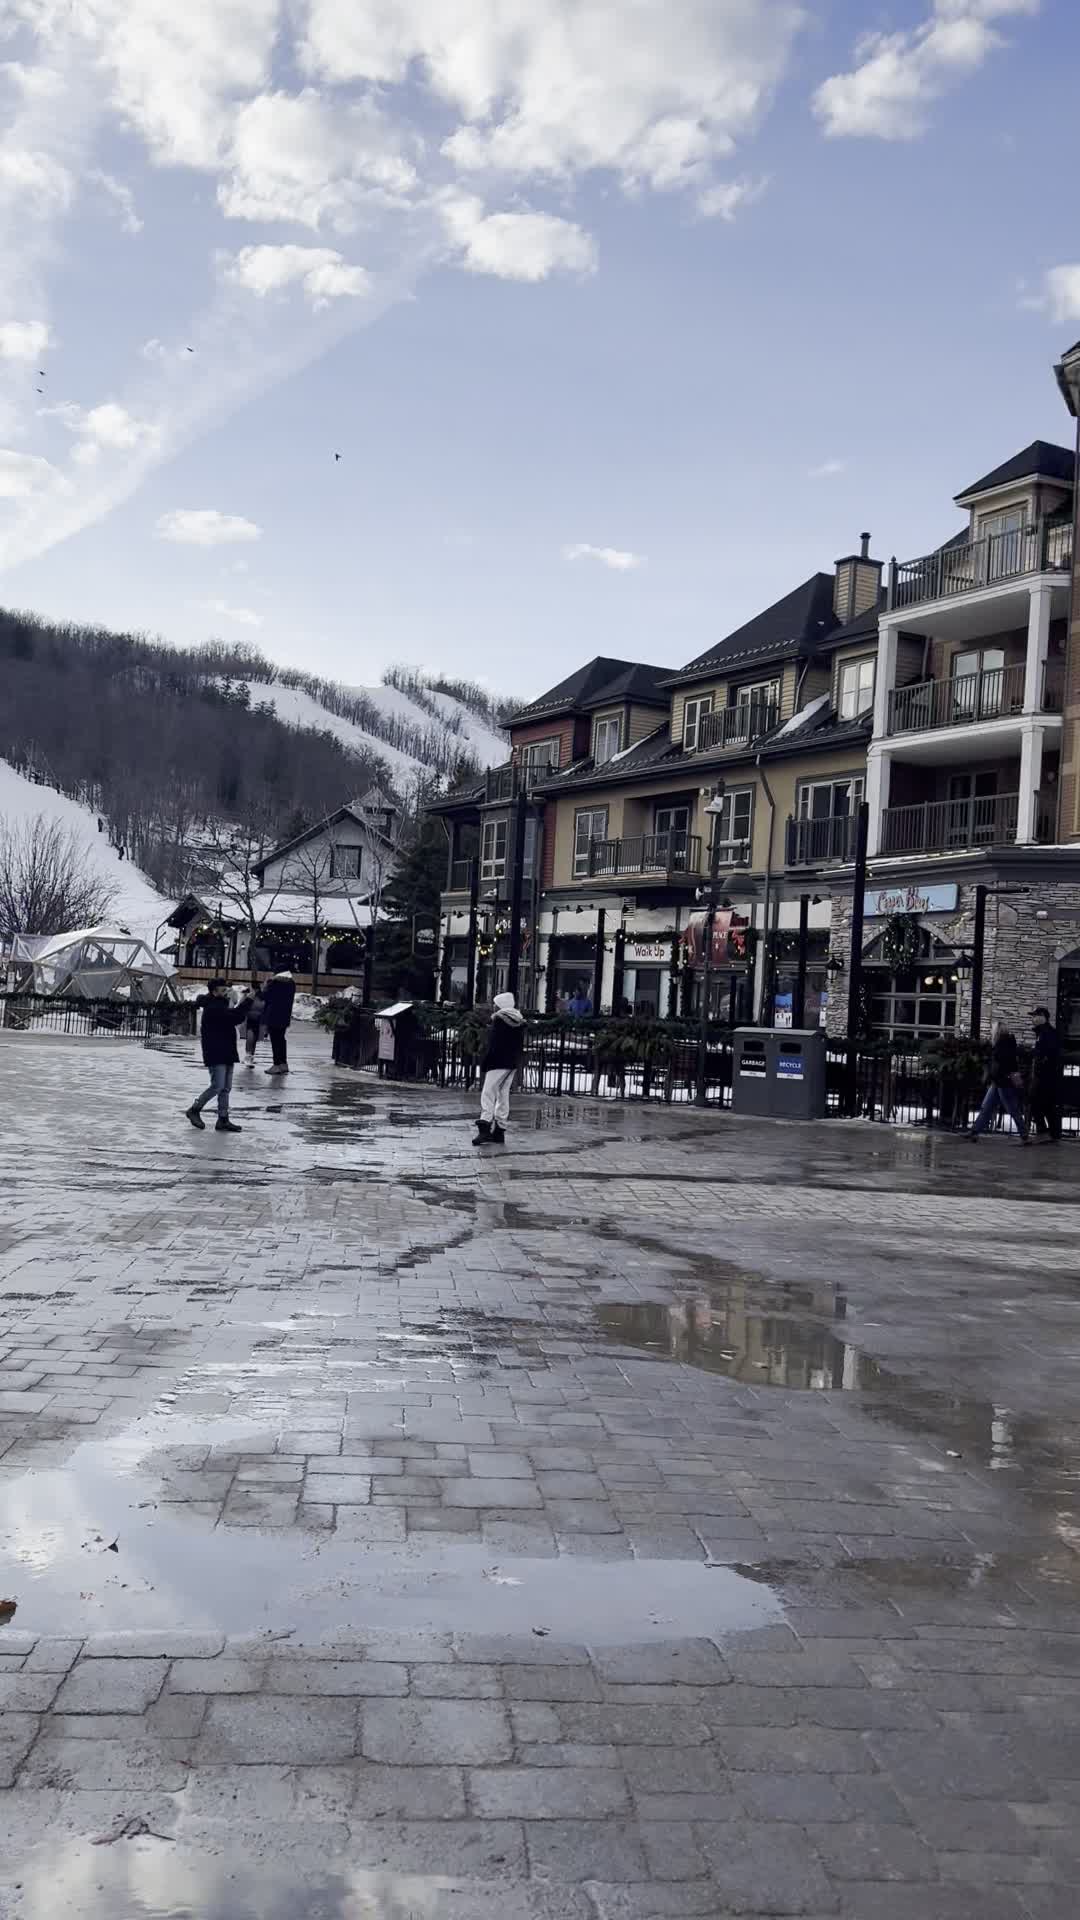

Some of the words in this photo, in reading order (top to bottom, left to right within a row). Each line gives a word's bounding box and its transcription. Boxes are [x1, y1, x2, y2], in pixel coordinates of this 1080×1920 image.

[634, 945, 653, 957] Walk
[654, 945, 665, 960] Up
[741, 1059, 766, 1067] GARBAGE
[779, 1061, 802, 1069] RECYCLE
